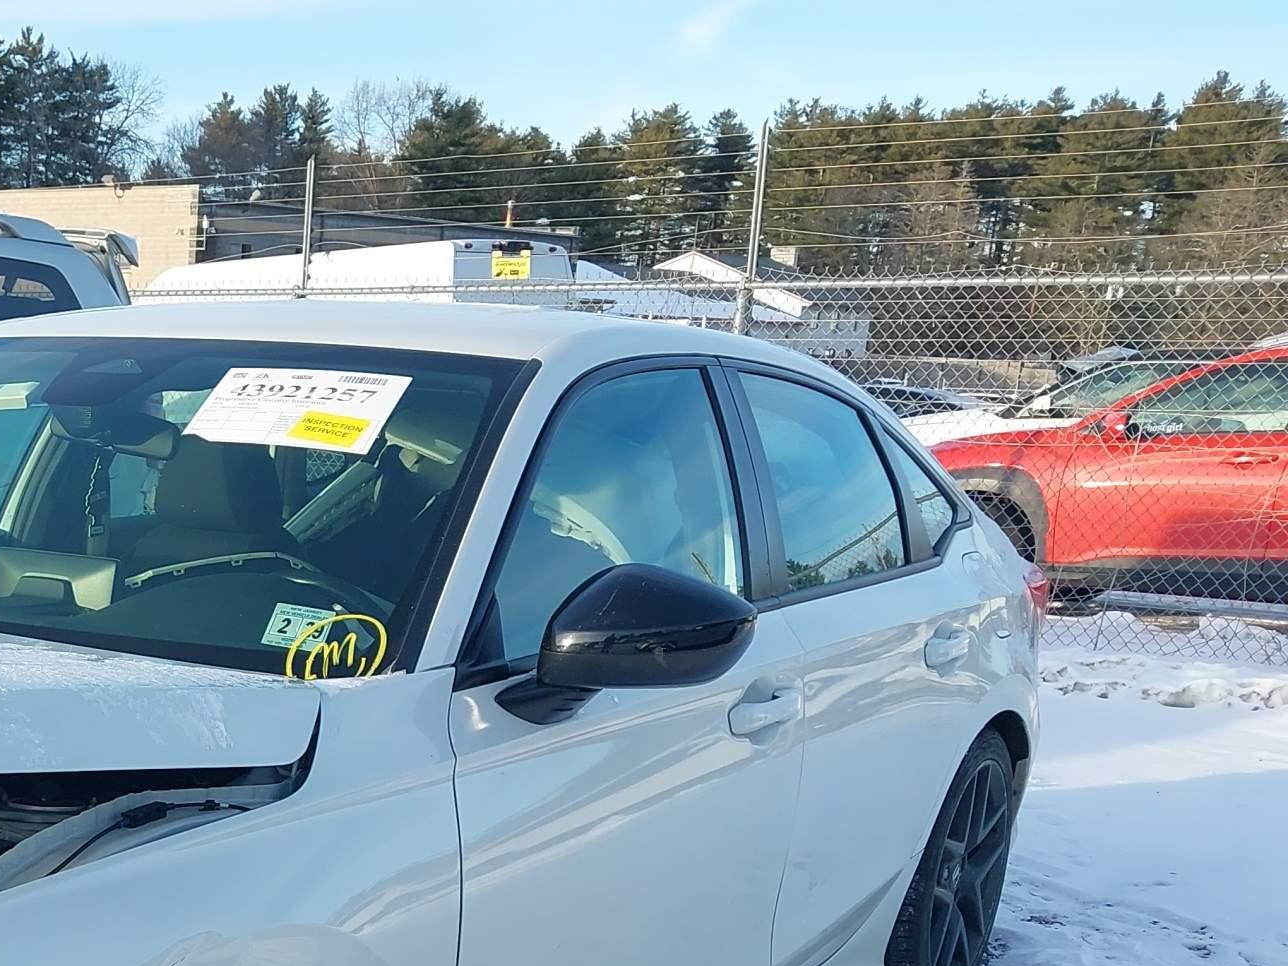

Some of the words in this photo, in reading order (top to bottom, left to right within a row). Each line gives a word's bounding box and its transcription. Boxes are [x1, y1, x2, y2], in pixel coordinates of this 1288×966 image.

[230, 383, 378, 404] 43921257
[302, 417, 364, 433] INSPECTION
[304, 425, 351, 438] SERVICE
[277, 618, 291, 634] 2
